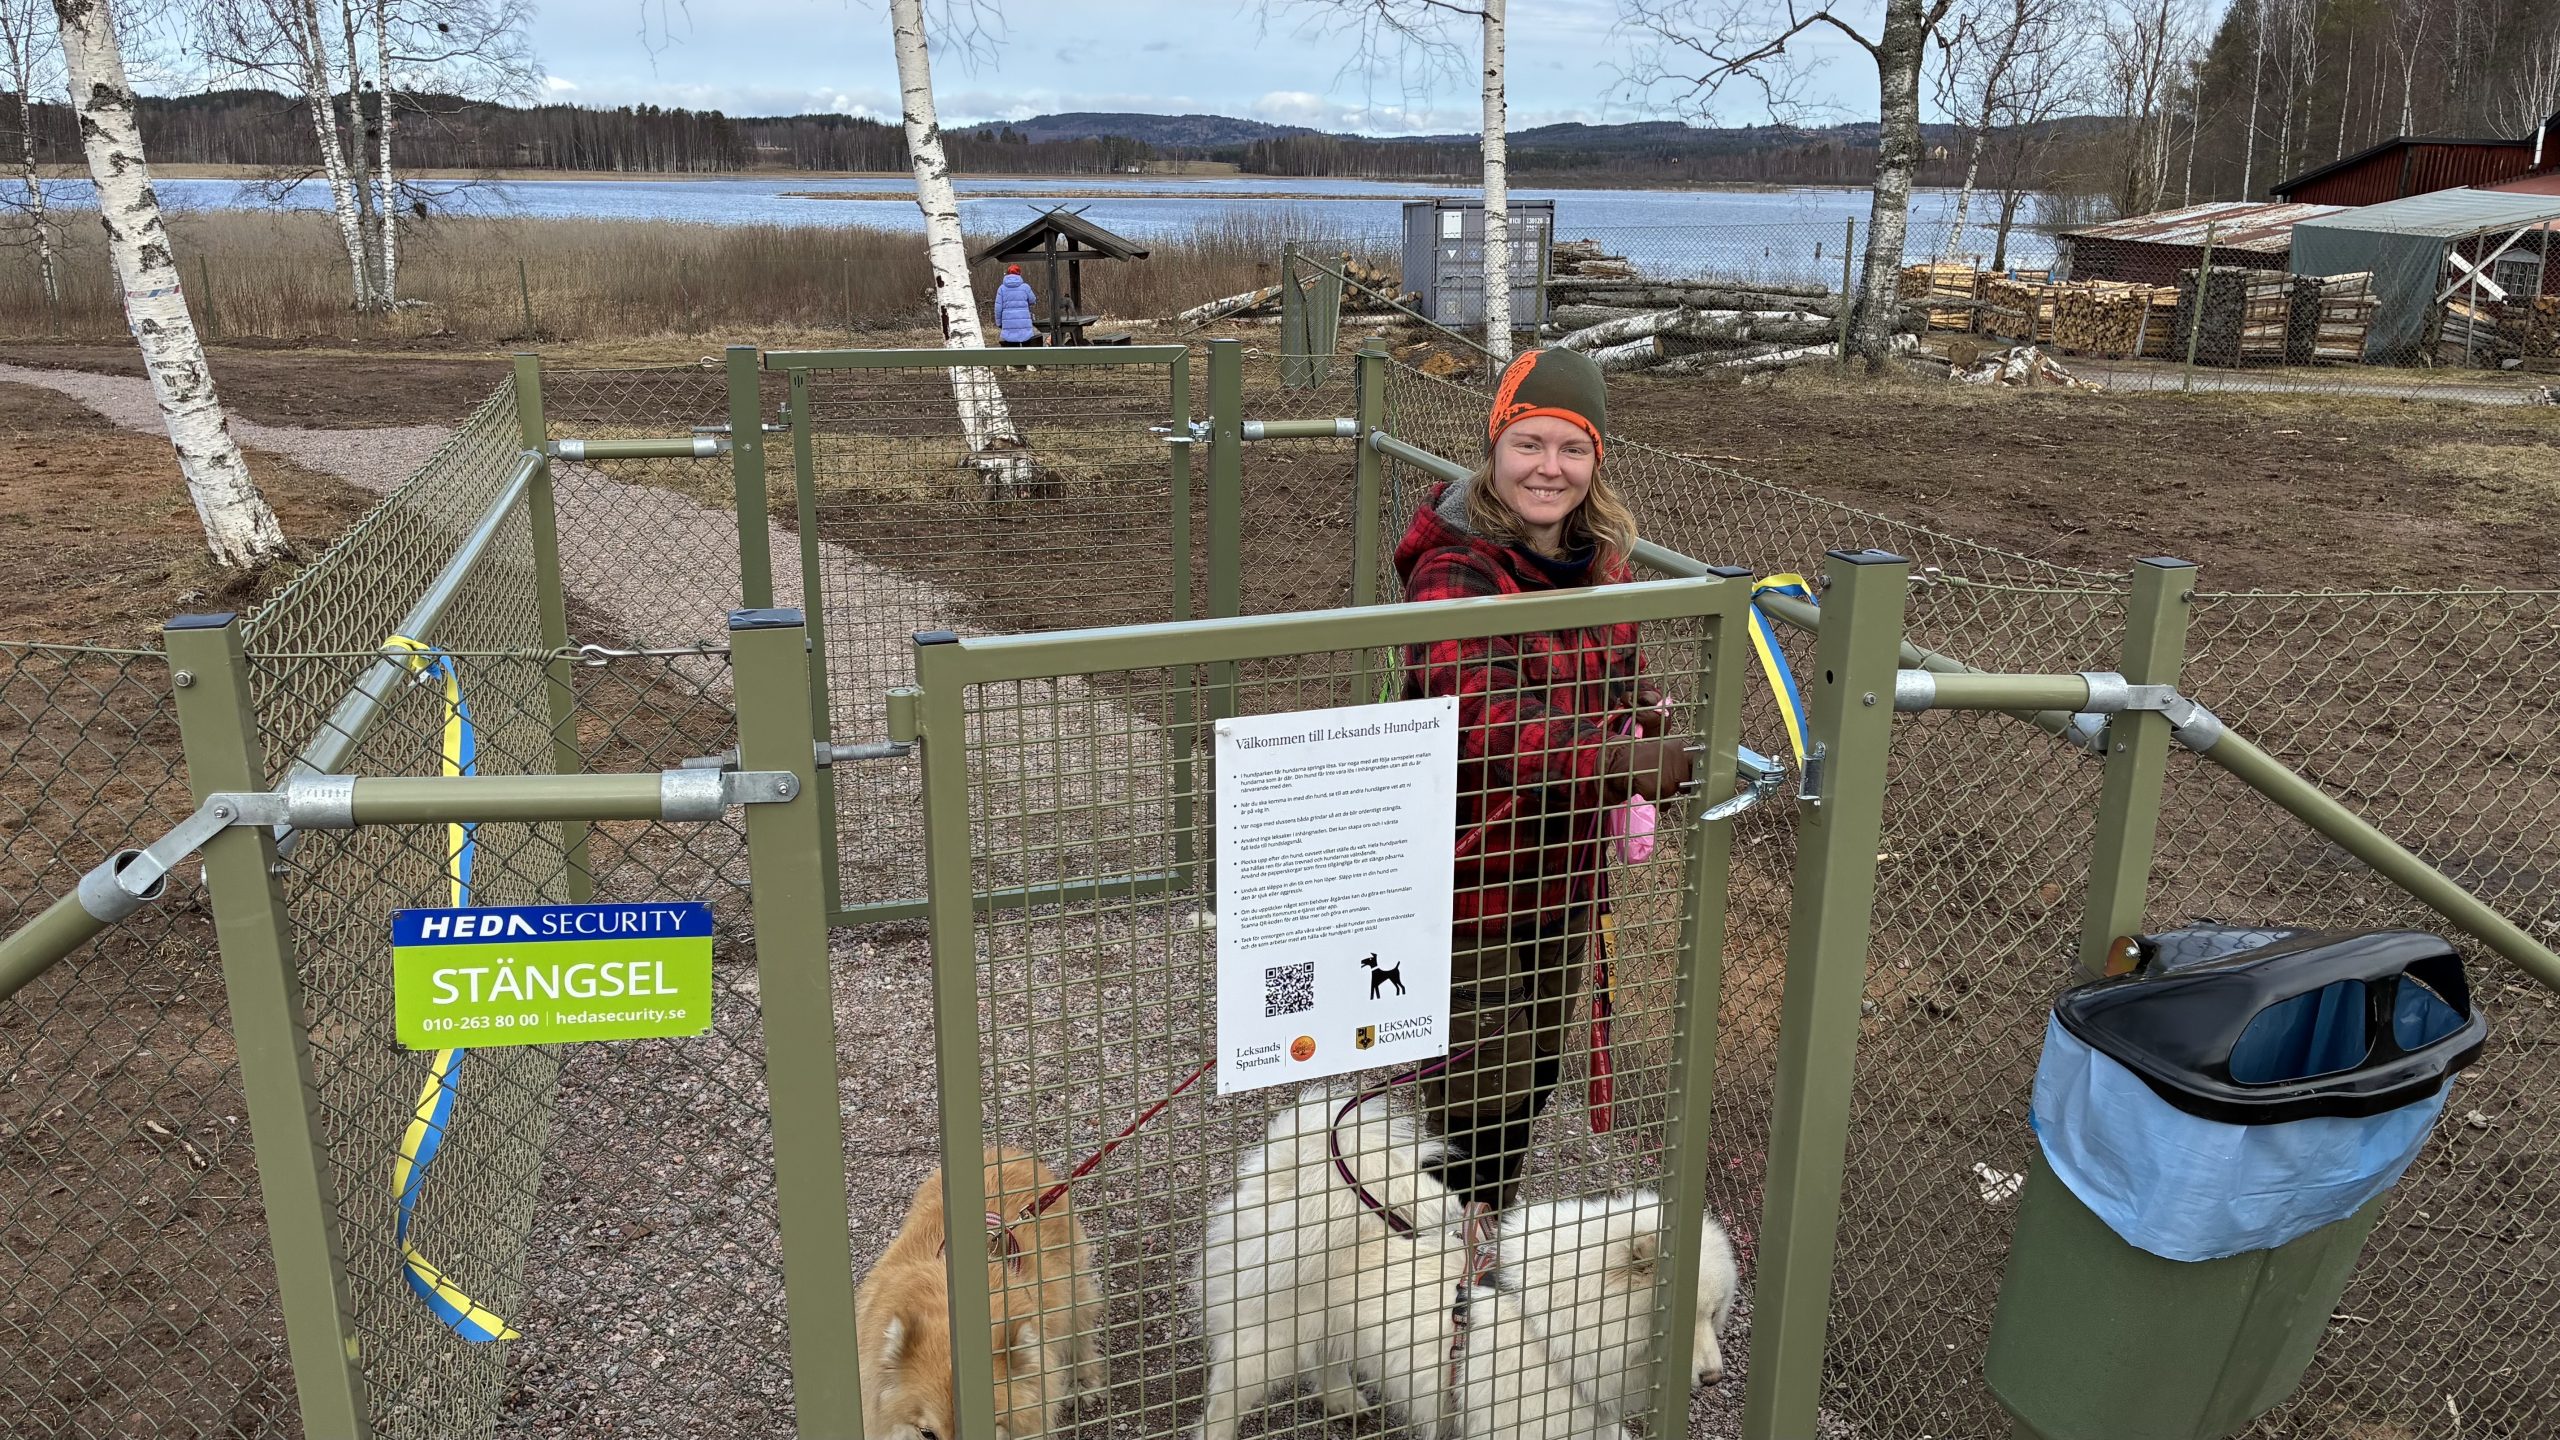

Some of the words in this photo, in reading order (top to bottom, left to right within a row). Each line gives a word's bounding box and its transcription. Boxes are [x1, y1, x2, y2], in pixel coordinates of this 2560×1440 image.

[1236, 733, 1305, 750] Välkommen
[1308, 730, 1324, 742] till
[1327, 724, 1381, 741] Leksands
[1383, 716, 1440, 736] Hundpark
[1243, 770, 1273, 778] hundparken
[1240, 785, 1269, 793] närvarande
[1309, 814, 1327, 822] grindar
[1294, 857, 1313, 865] trevnad
[1240, 871, 1259, 880] Använd
[421, 915, 537, 939] HEDA
[542, 910, 686, 935] SECURITY
[432, 957, 678, 1005] STÄNGSEL
[423, 1016, 490, 1032] 010-263
[495, 1014, 514, 1028] 80
[520, 1013, 539, 1027] 00
[556, 1007, 686, 1026] hedasecurity.se
[1379, 1015, 1433, 1033] LEKSANDS
[1379, 1026, 1432, 1044] KOMMUN
[1236, 1042, 1281, 1058] Leksands
[1235, 1054, 1280, 1071] Sparbank
